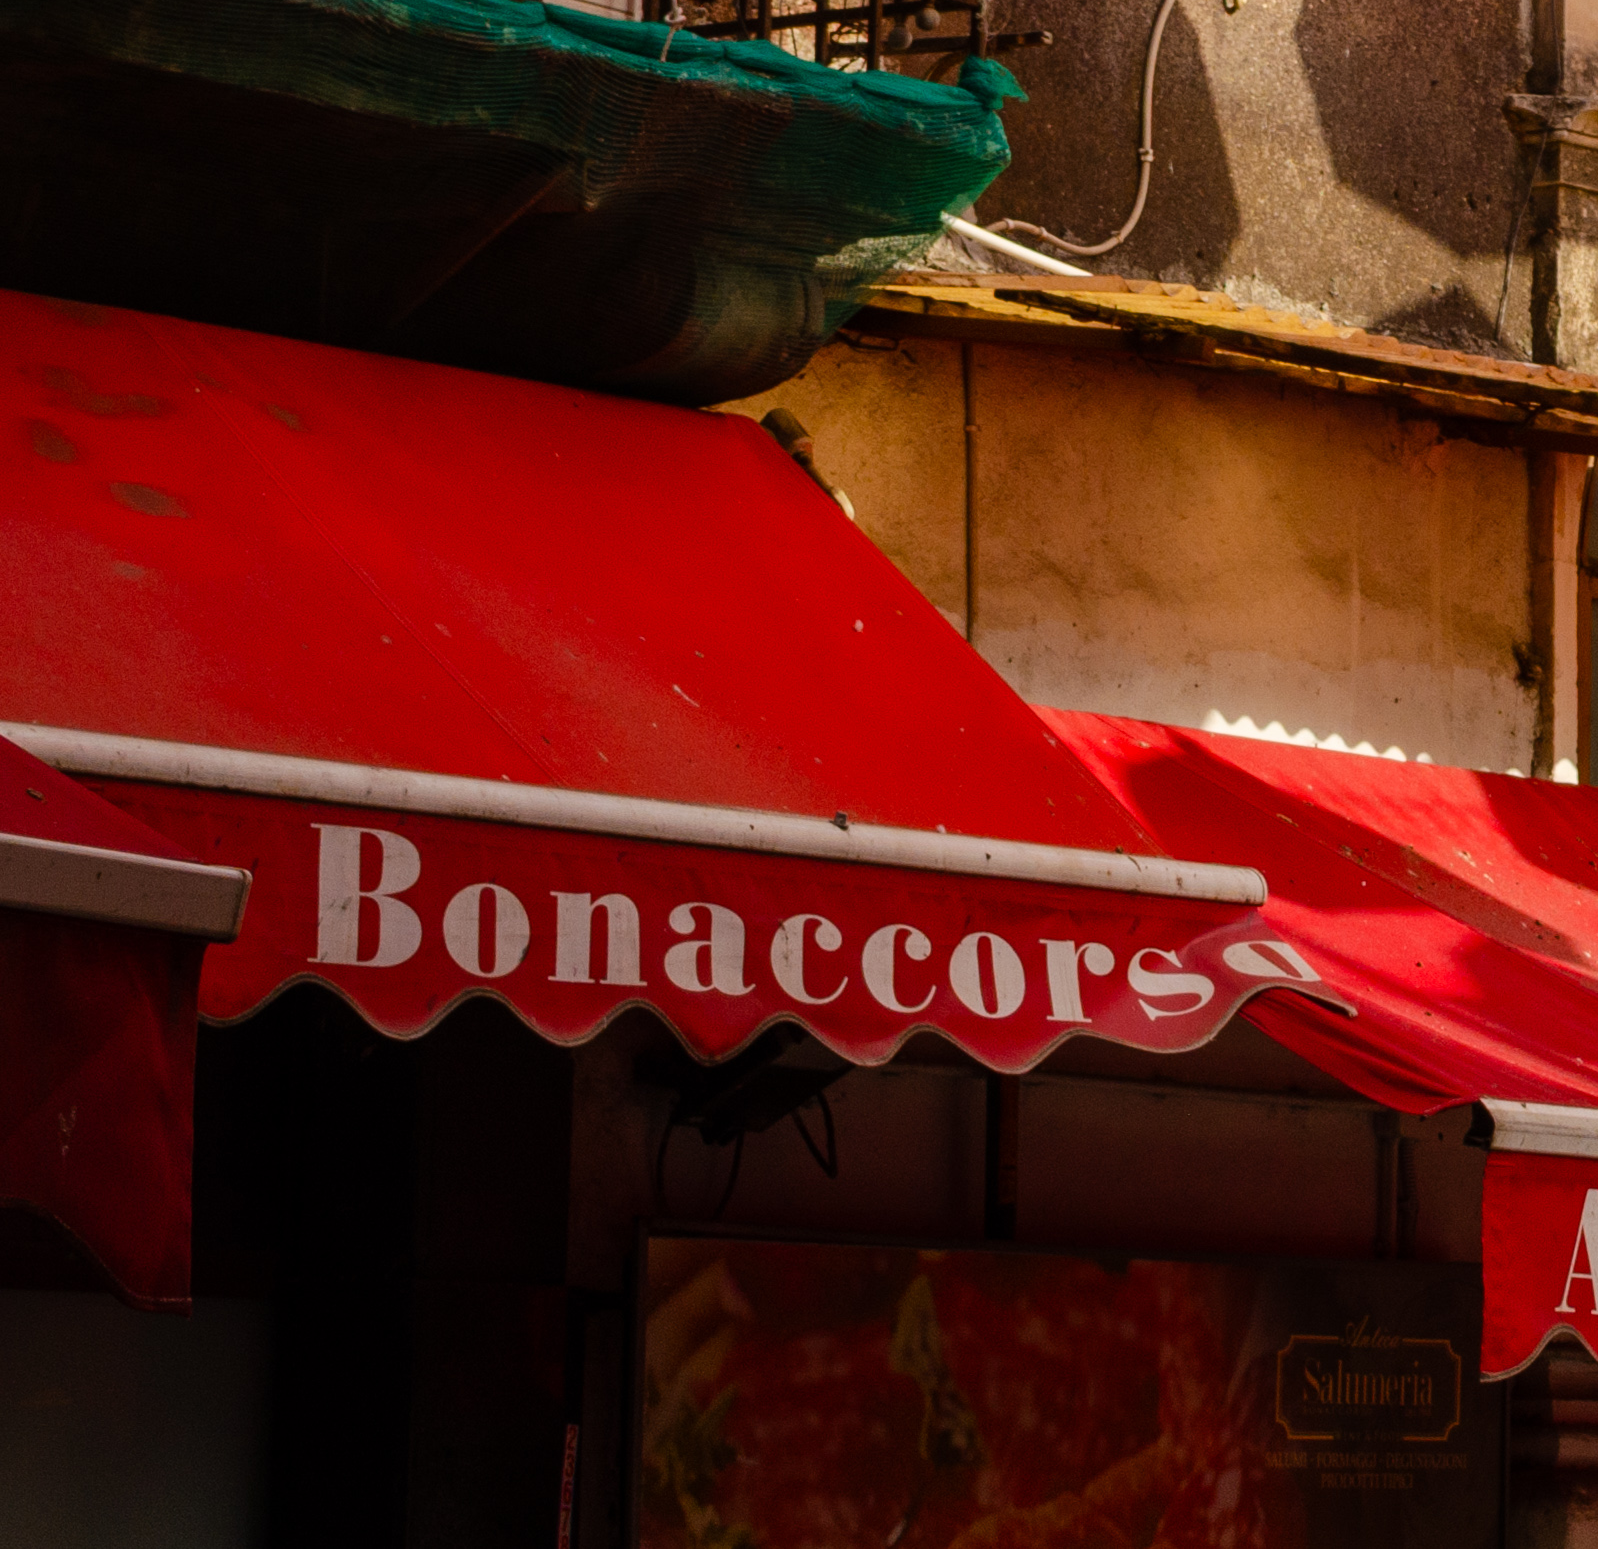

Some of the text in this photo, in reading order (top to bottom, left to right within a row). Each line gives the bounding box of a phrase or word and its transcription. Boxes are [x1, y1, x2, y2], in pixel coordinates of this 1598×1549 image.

[307, 822, 1322, 1023] Bonaccorso
[1339, 1315, 1401, 1347] Antica
[1303, 1358, 1432, 1406] Salumeria
[1316, 1451, 1377, 1469] FORMAGGI
[1320, 1472, 1379, 1489] PRODOTTI
